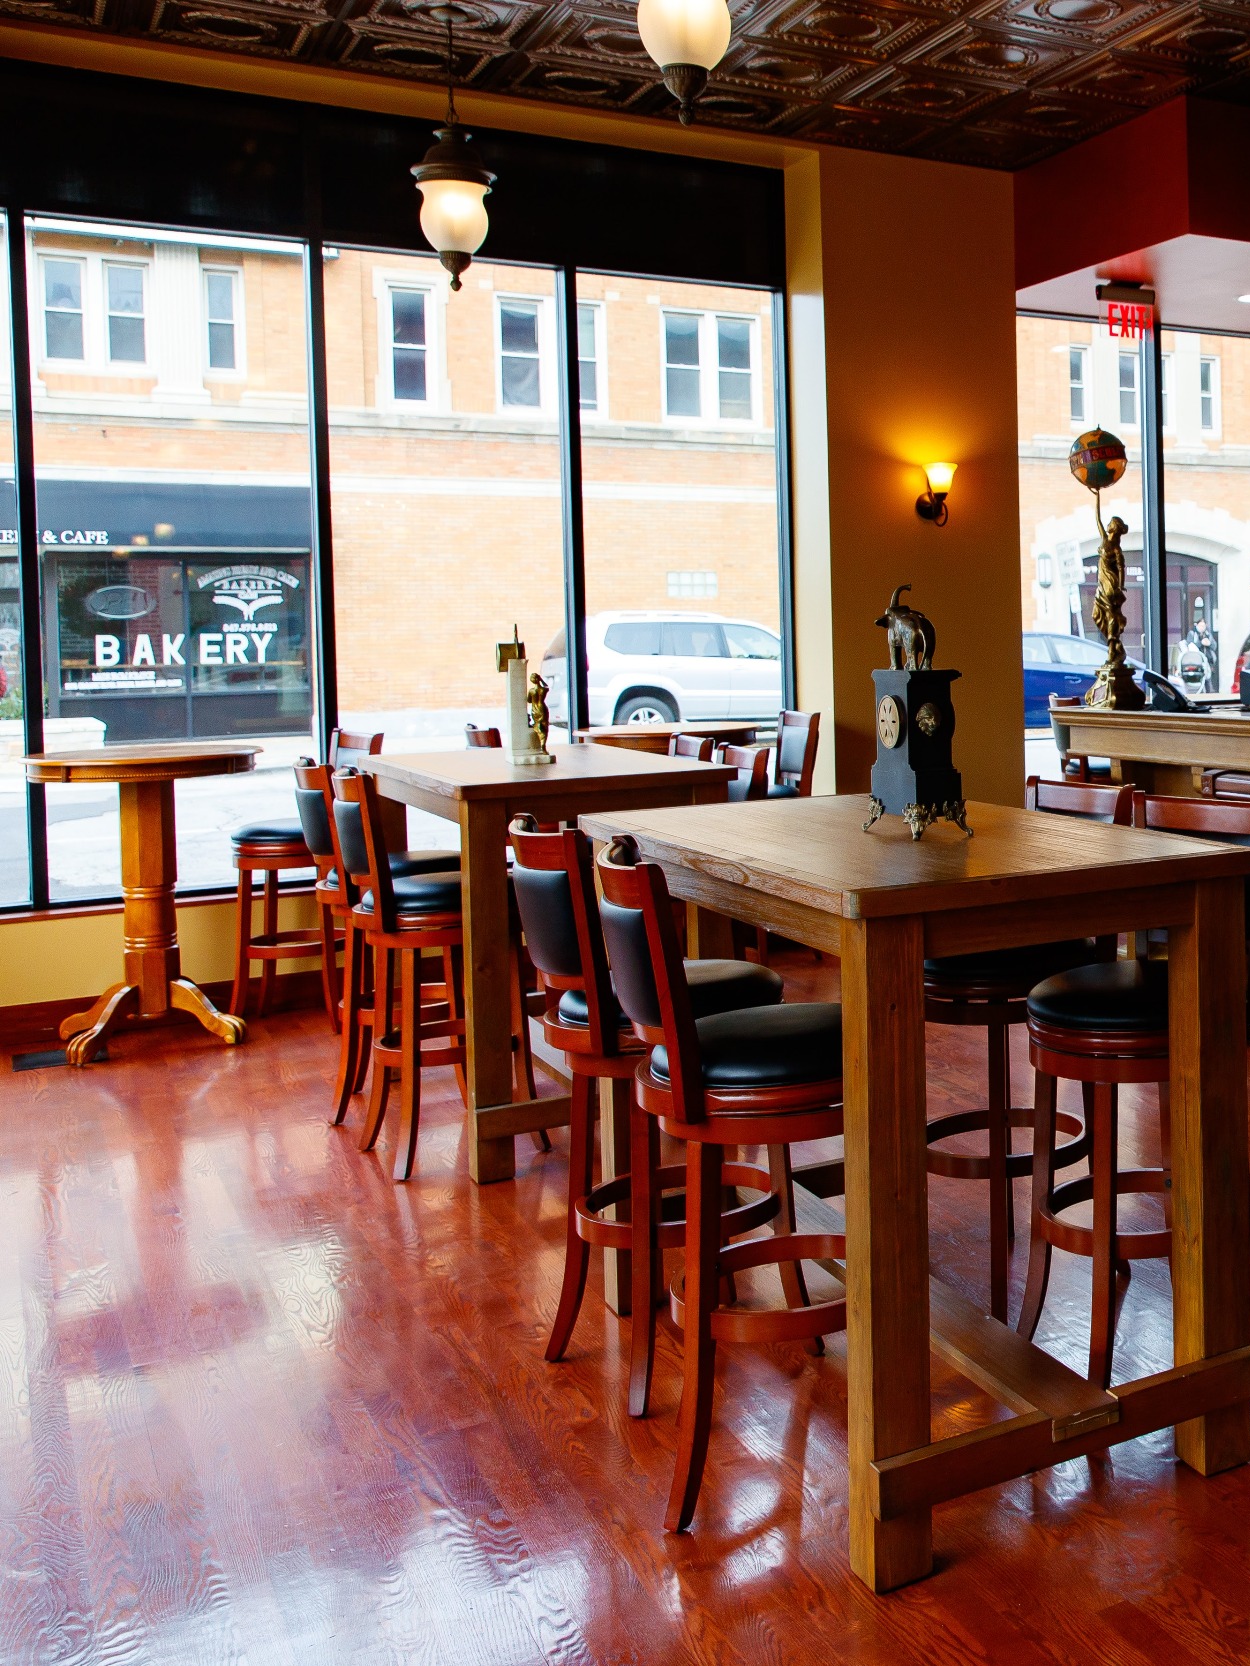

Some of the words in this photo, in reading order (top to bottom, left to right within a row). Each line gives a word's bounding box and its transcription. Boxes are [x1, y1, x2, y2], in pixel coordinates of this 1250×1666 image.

[1108, 303, 1147, 340] EXIT
[42, 529, 58, 544] &
[60, 530, 109, 544] CAFE
[95, 633, 273, 667] BAKERY
